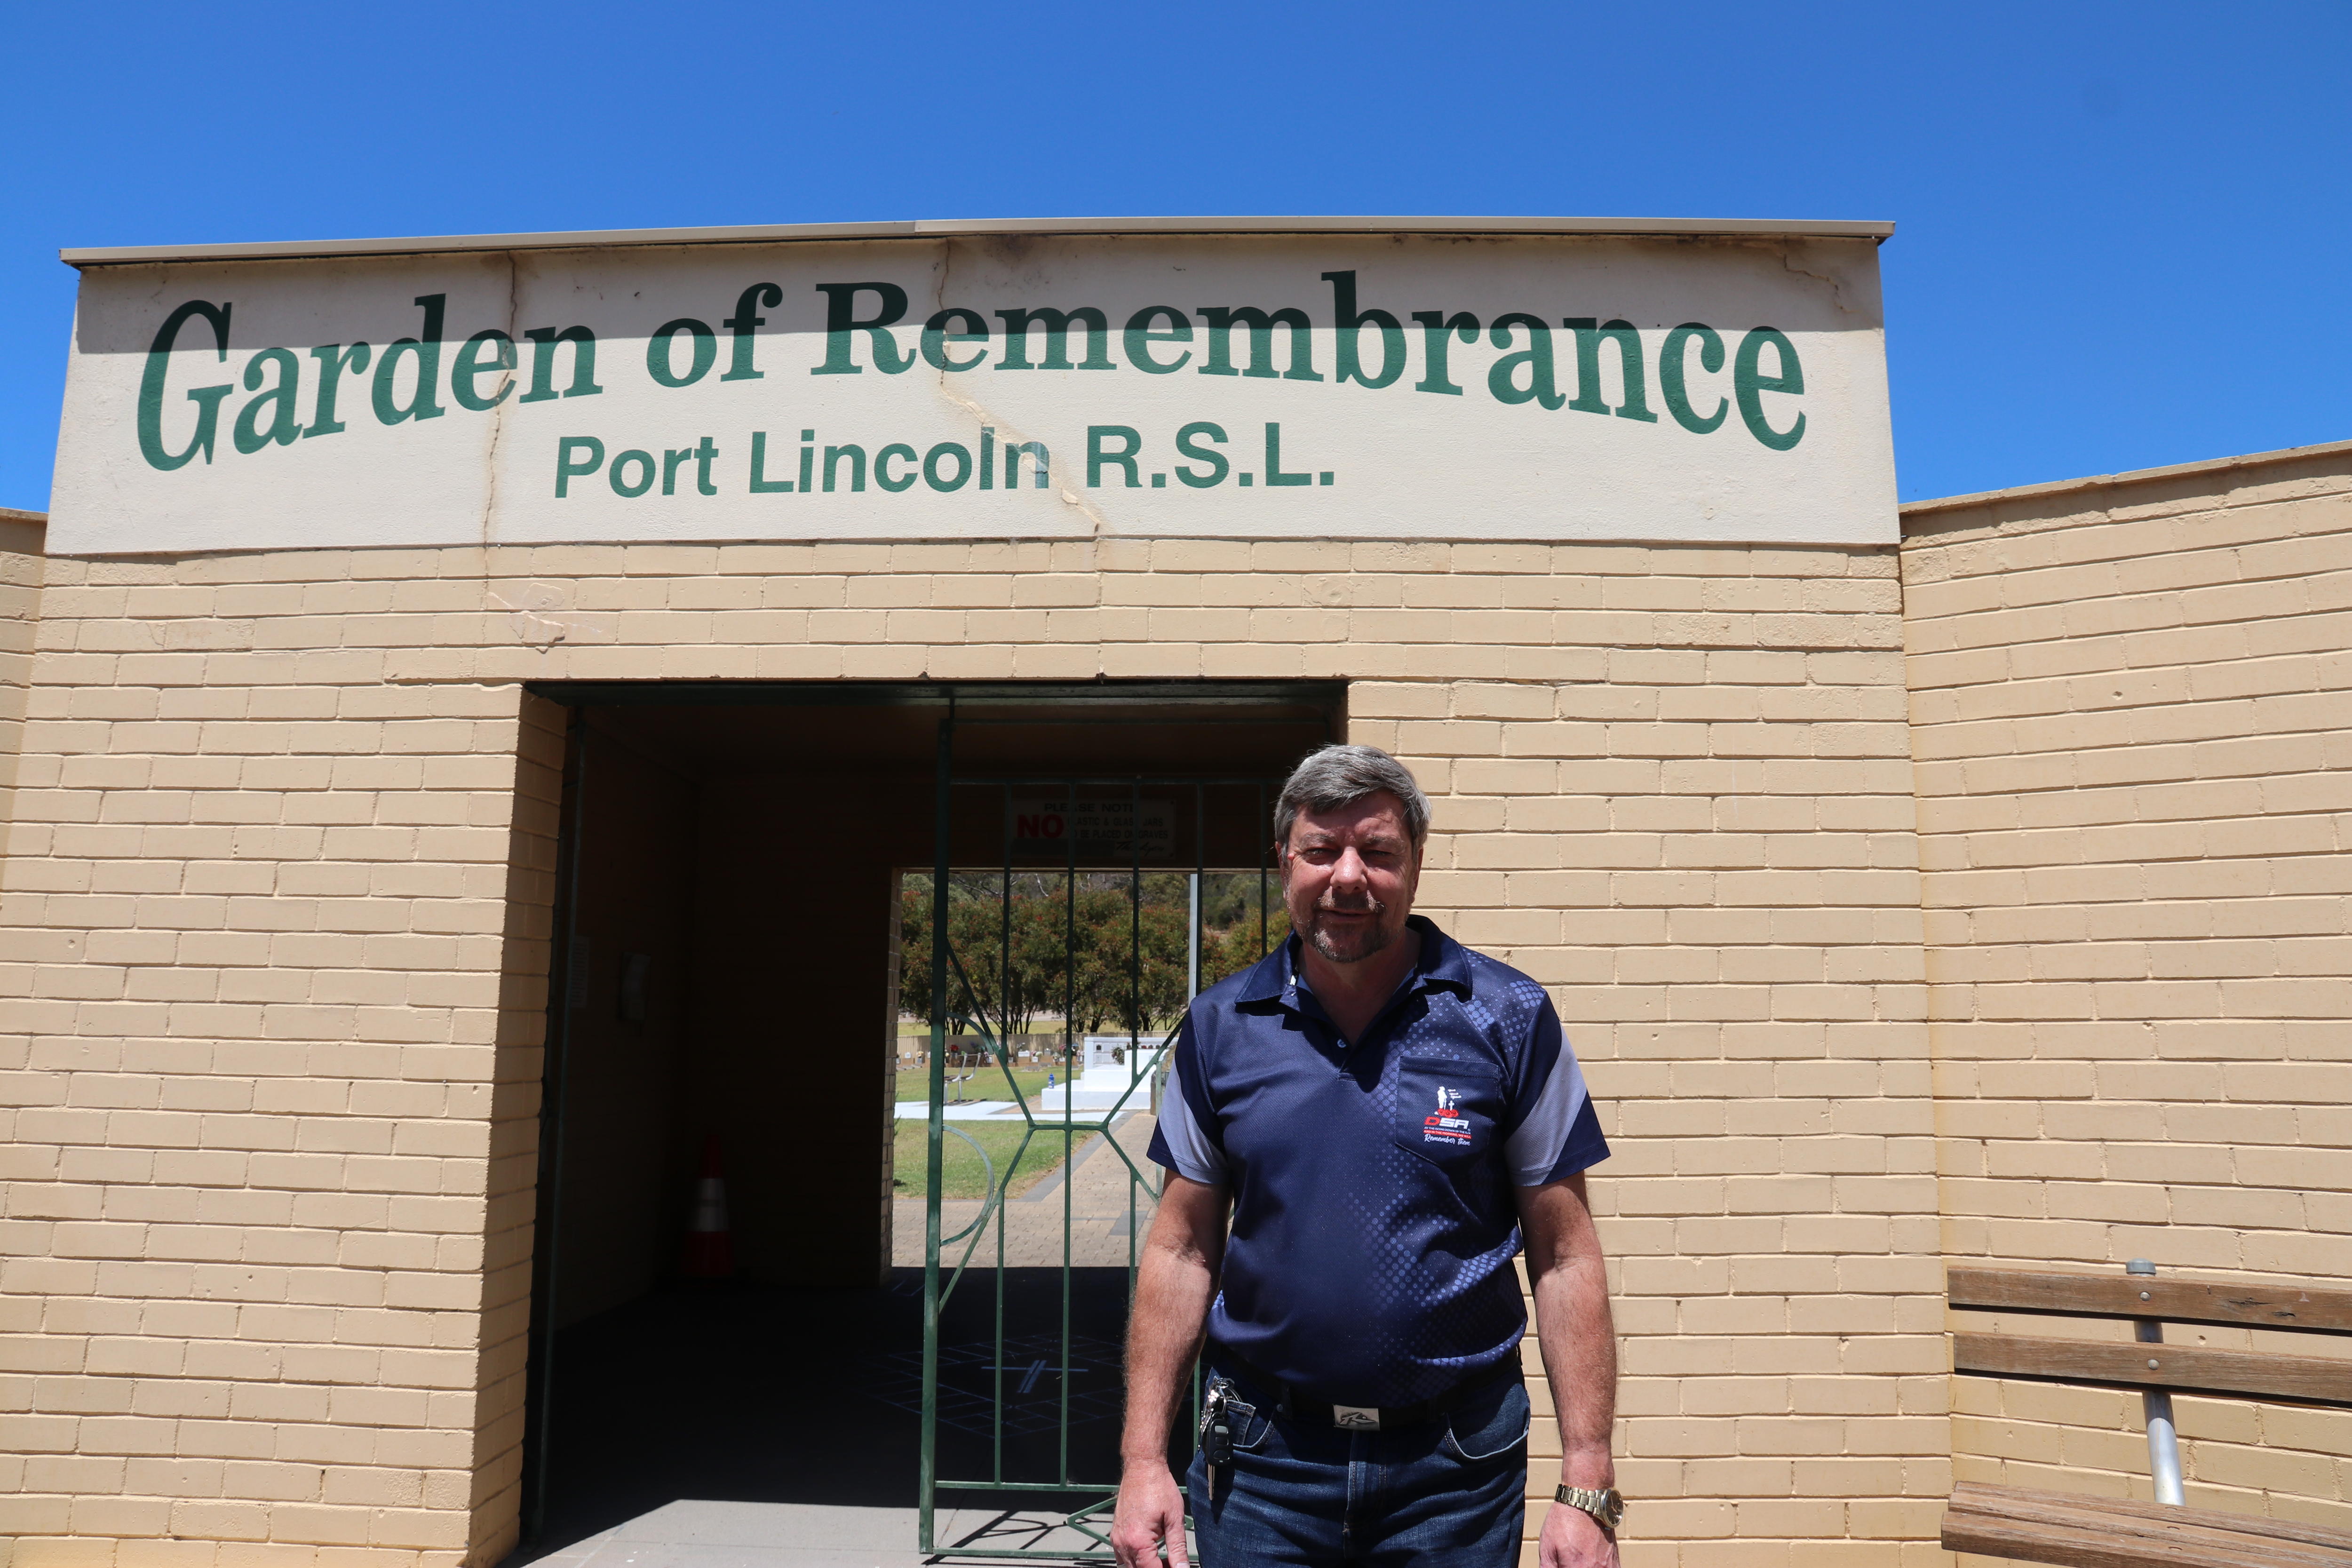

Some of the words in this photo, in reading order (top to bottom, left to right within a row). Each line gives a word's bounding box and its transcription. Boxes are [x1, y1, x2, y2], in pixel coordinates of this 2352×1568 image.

[137, 293, 603, 472] Garden
[647, 282, 783, 389] of
[810, 269, 1807, 452] Remembrance
[555, 437, 720, 499] Port
[749, 427, 1049, 493] Lincoln
[1087, 422, 1335, 489] R.S.L.
[1044, 803, 1096, 812] PLESE
[1017, 814, 1064, 839] NO
[1068, 817, 1099, 826] ASTIC
[1113, 817, 1134, 826] GLAS
[1143, 818, 1163, 827] JARS
[1080, 830, 1090, 838] BE
[1093, 830, 1121, 839] PLACED
[1138, 830, 1168, 839] GRAVES
[1424, 1133, 1455, 1144] Remember
[1458, 1137, 1470, 1146] them
